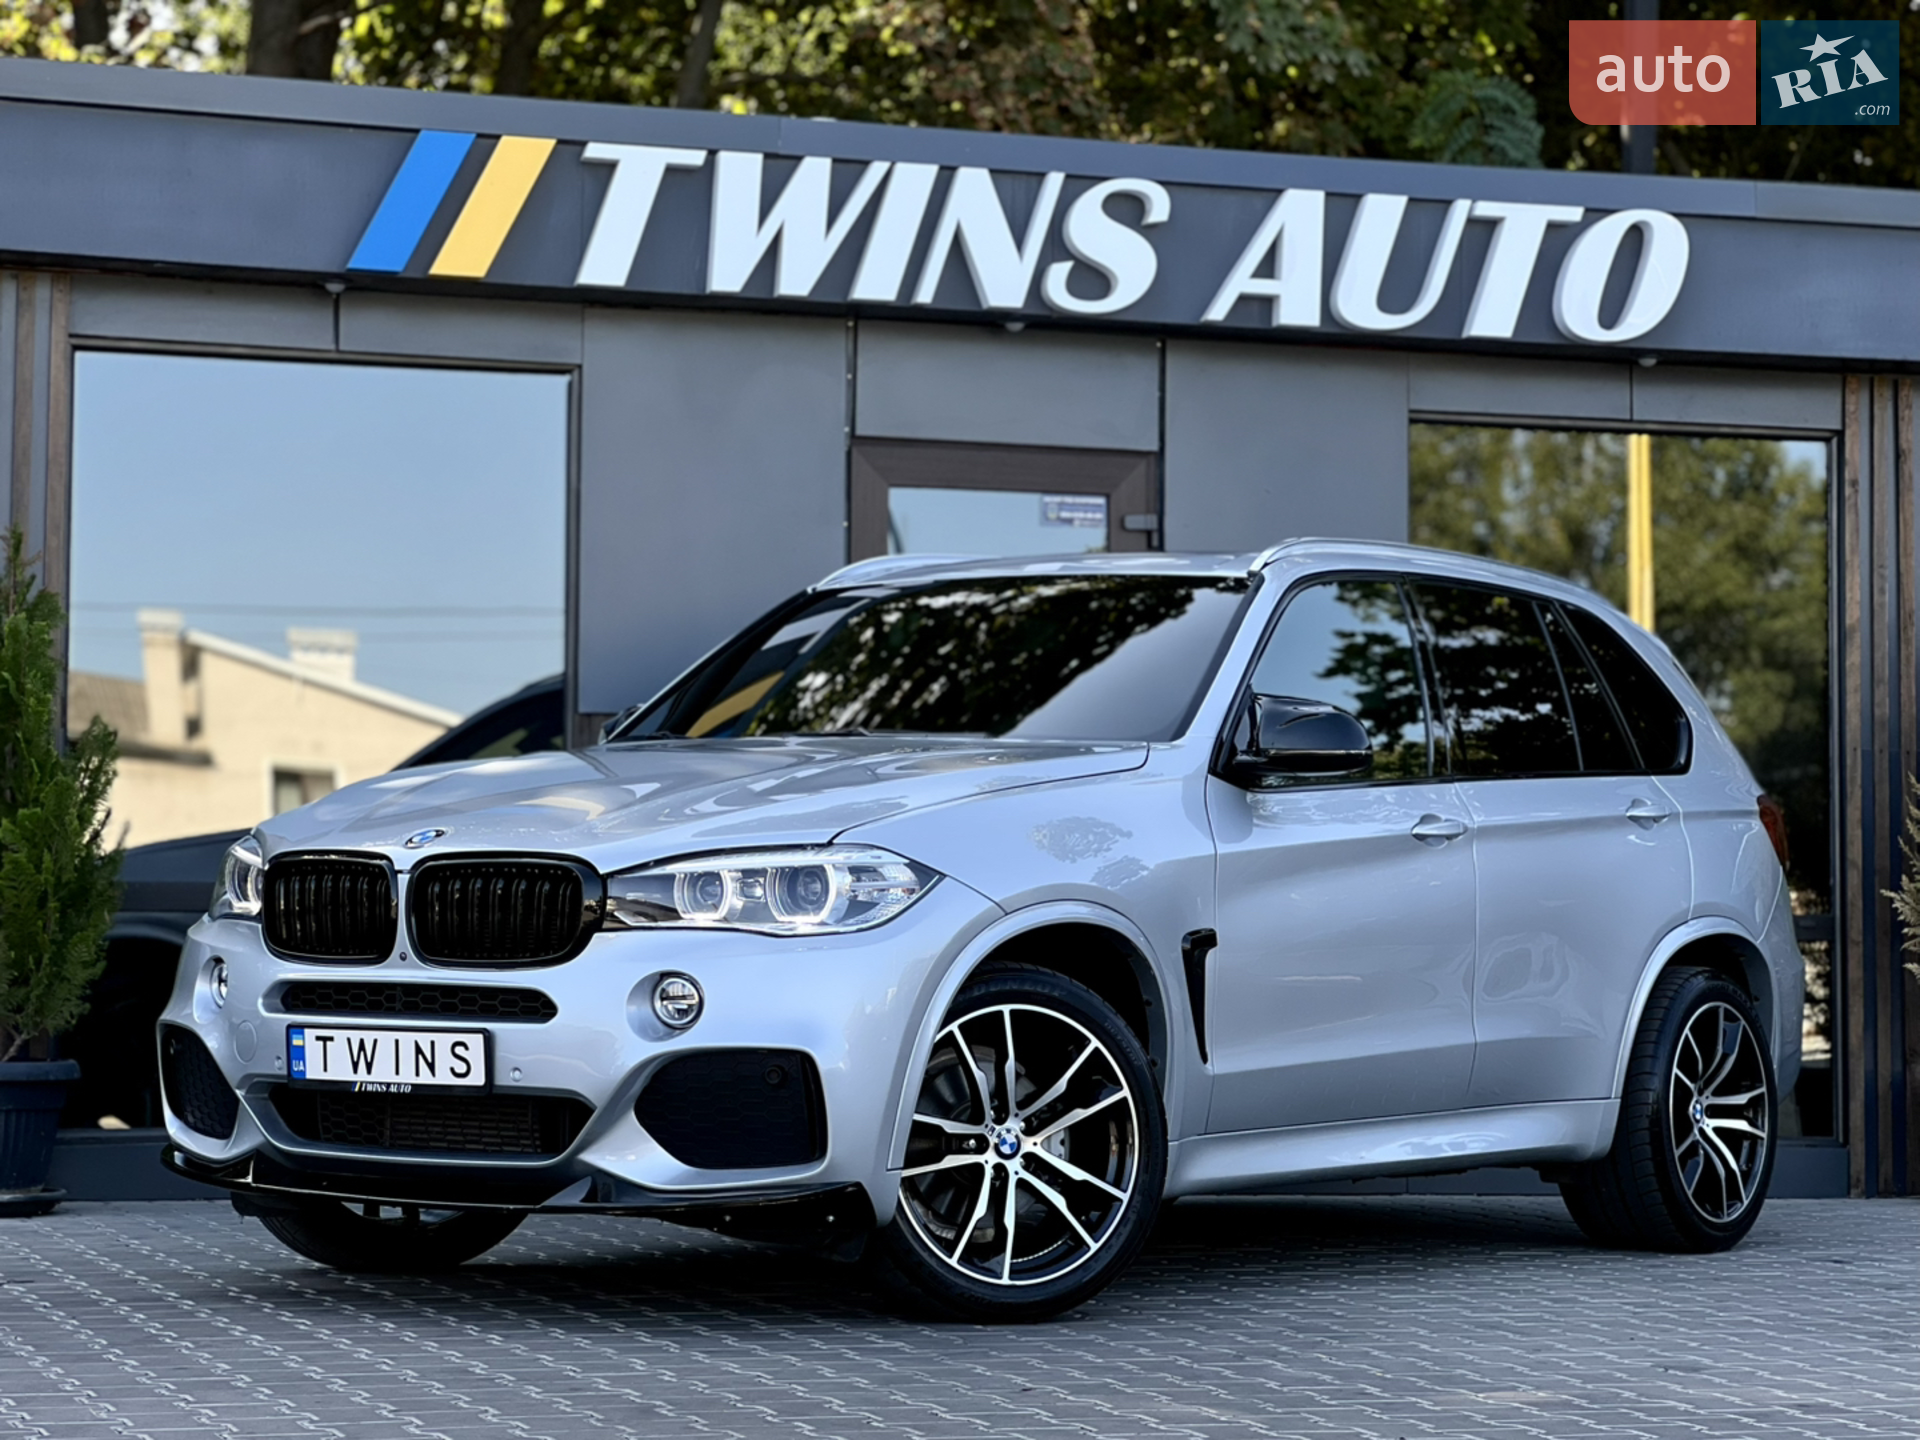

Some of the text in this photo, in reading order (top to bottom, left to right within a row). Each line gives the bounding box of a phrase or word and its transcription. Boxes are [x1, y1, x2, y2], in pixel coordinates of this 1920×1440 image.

[574, 141, 1690, 343] TWINS AUTO
[292, 1059, 305, 1072] UA
[314, 1035, 472, 1079] TWINS
[361, 1082, 412, 1094] TWINS AUTO
